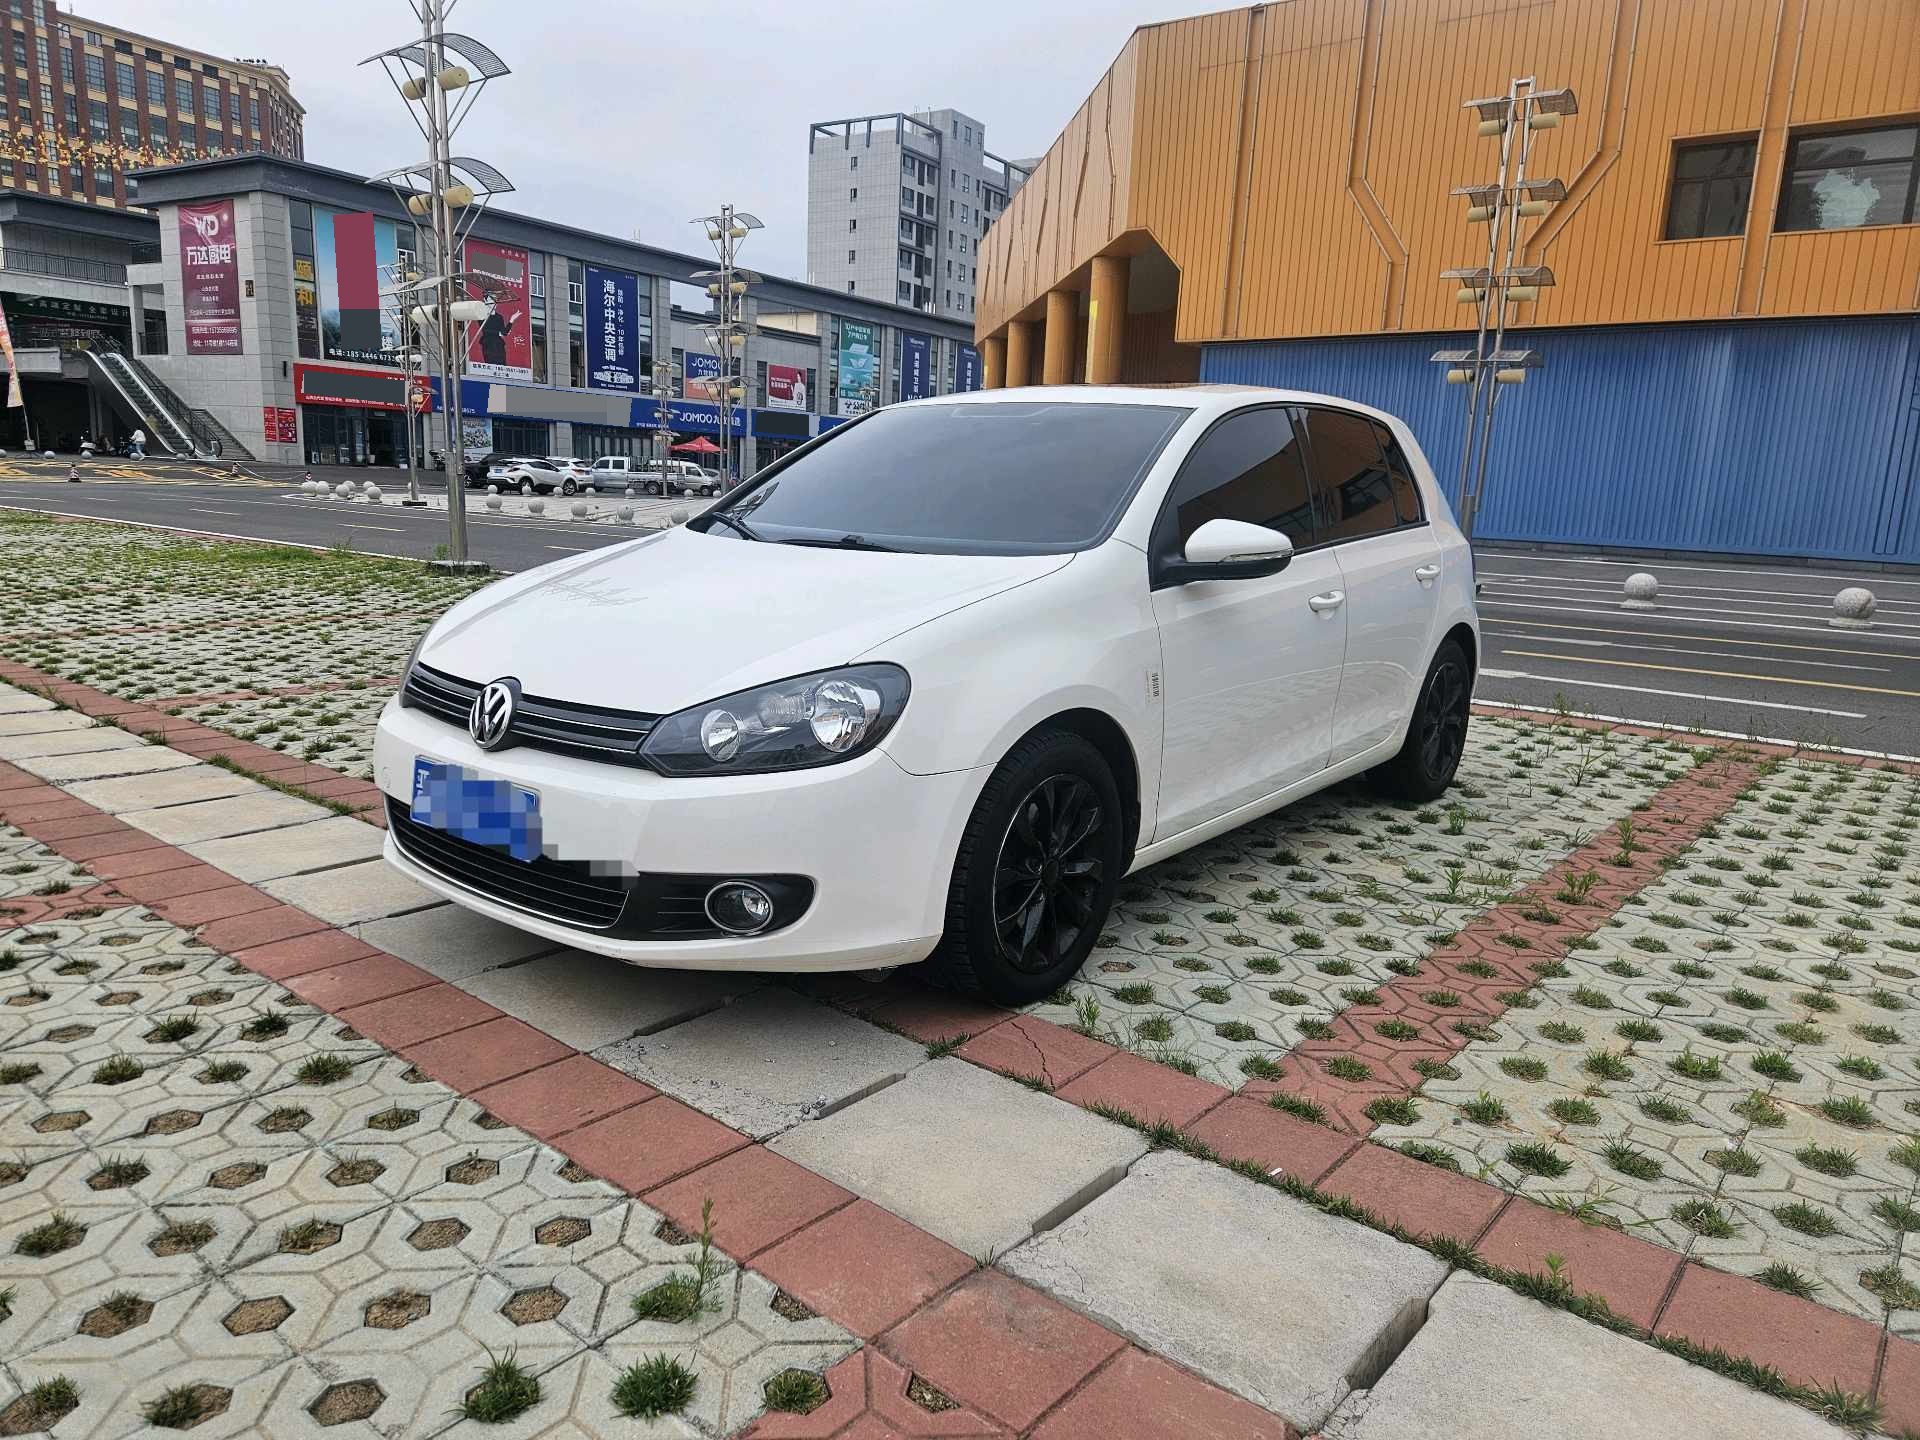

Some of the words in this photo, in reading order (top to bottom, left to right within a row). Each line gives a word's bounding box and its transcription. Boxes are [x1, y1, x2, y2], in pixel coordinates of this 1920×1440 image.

[603, 279, 616, 361] 海尔中央空调
[679, 412, 712, 424] JOMOO
